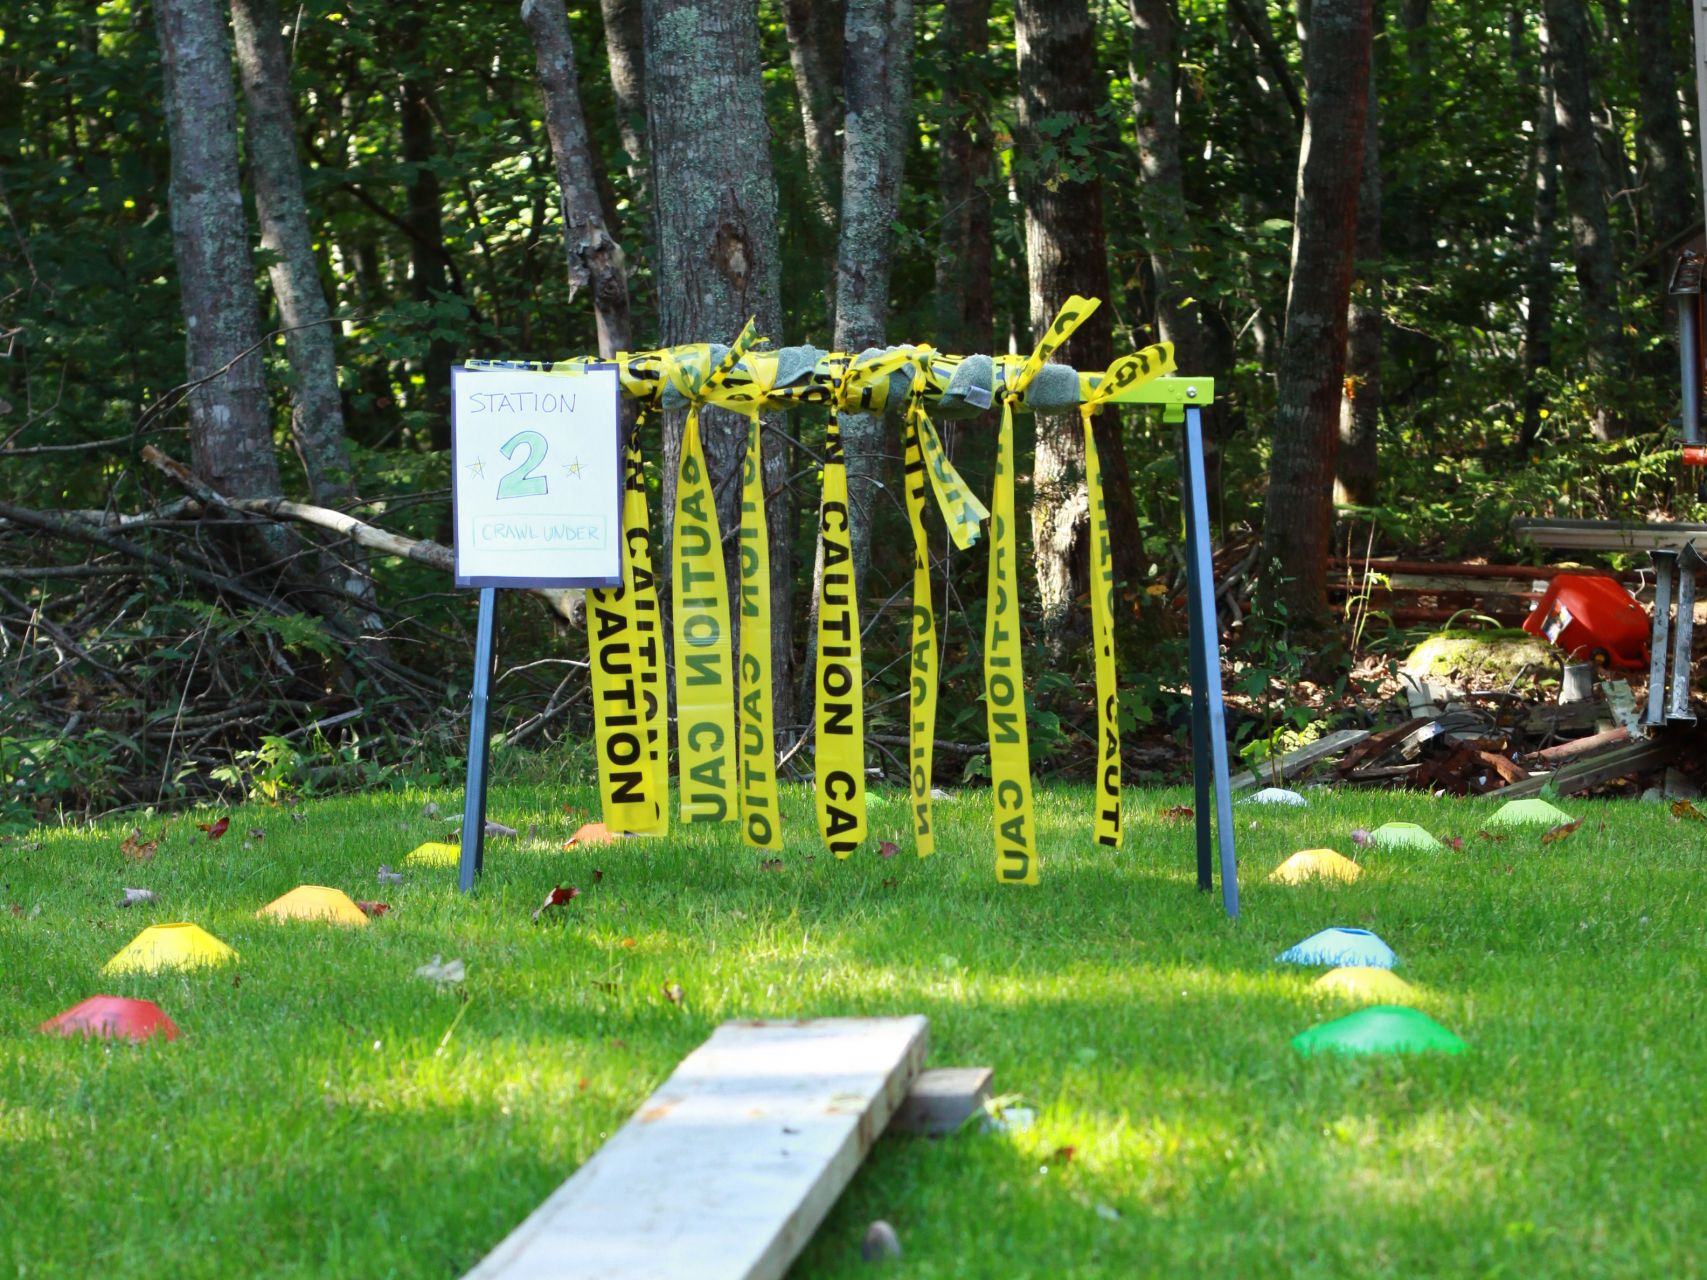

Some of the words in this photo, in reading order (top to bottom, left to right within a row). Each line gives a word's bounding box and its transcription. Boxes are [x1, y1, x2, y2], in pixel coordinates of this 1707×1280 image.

[469, 392, 576, 414] STATION
[496, 430, 549, 500] 2
[482, 522, 540, 542] CRAWL
[543, 524, 601, 542] UNDER
[822, 500, 854, 736] CAUTION
